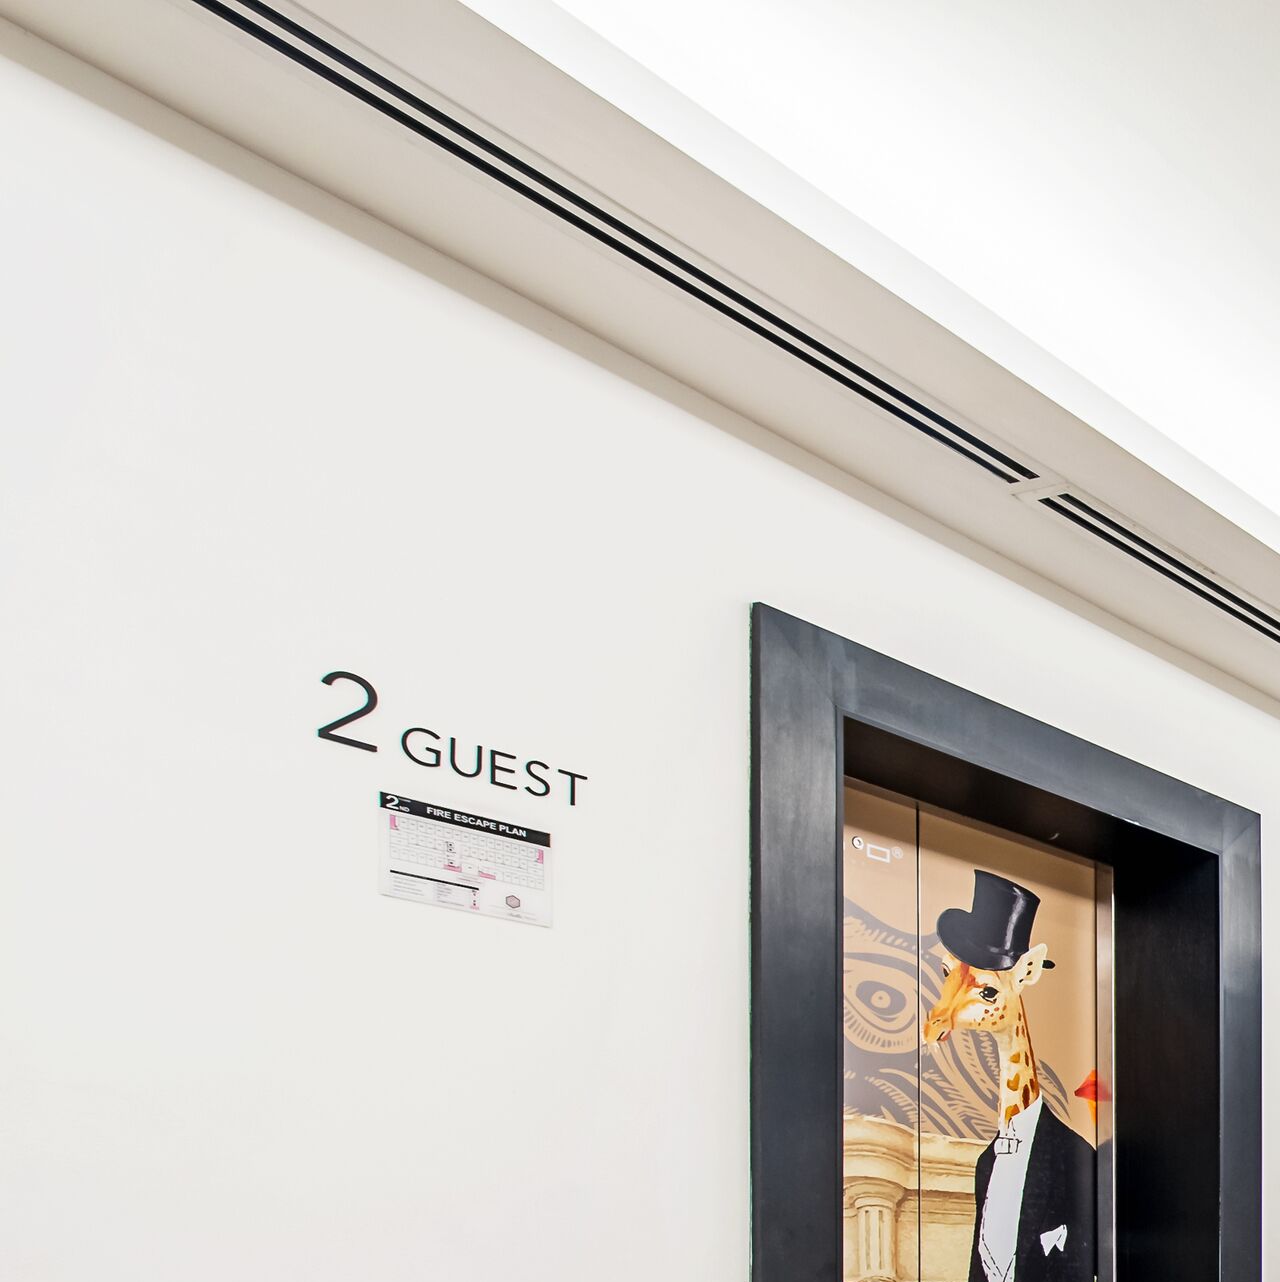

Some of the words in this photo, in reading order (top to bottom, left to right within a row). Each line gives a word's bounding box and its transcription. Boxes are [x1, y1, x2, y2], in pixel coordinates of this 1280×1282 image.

[317, 670, 378, 753] 2
[400, 727, 588, 806] GUEST
[426, 806, 451, 819] FIRE
[454, 813, 496, 830] ESCAPE
[498, 824, 526, 837] PLAN
